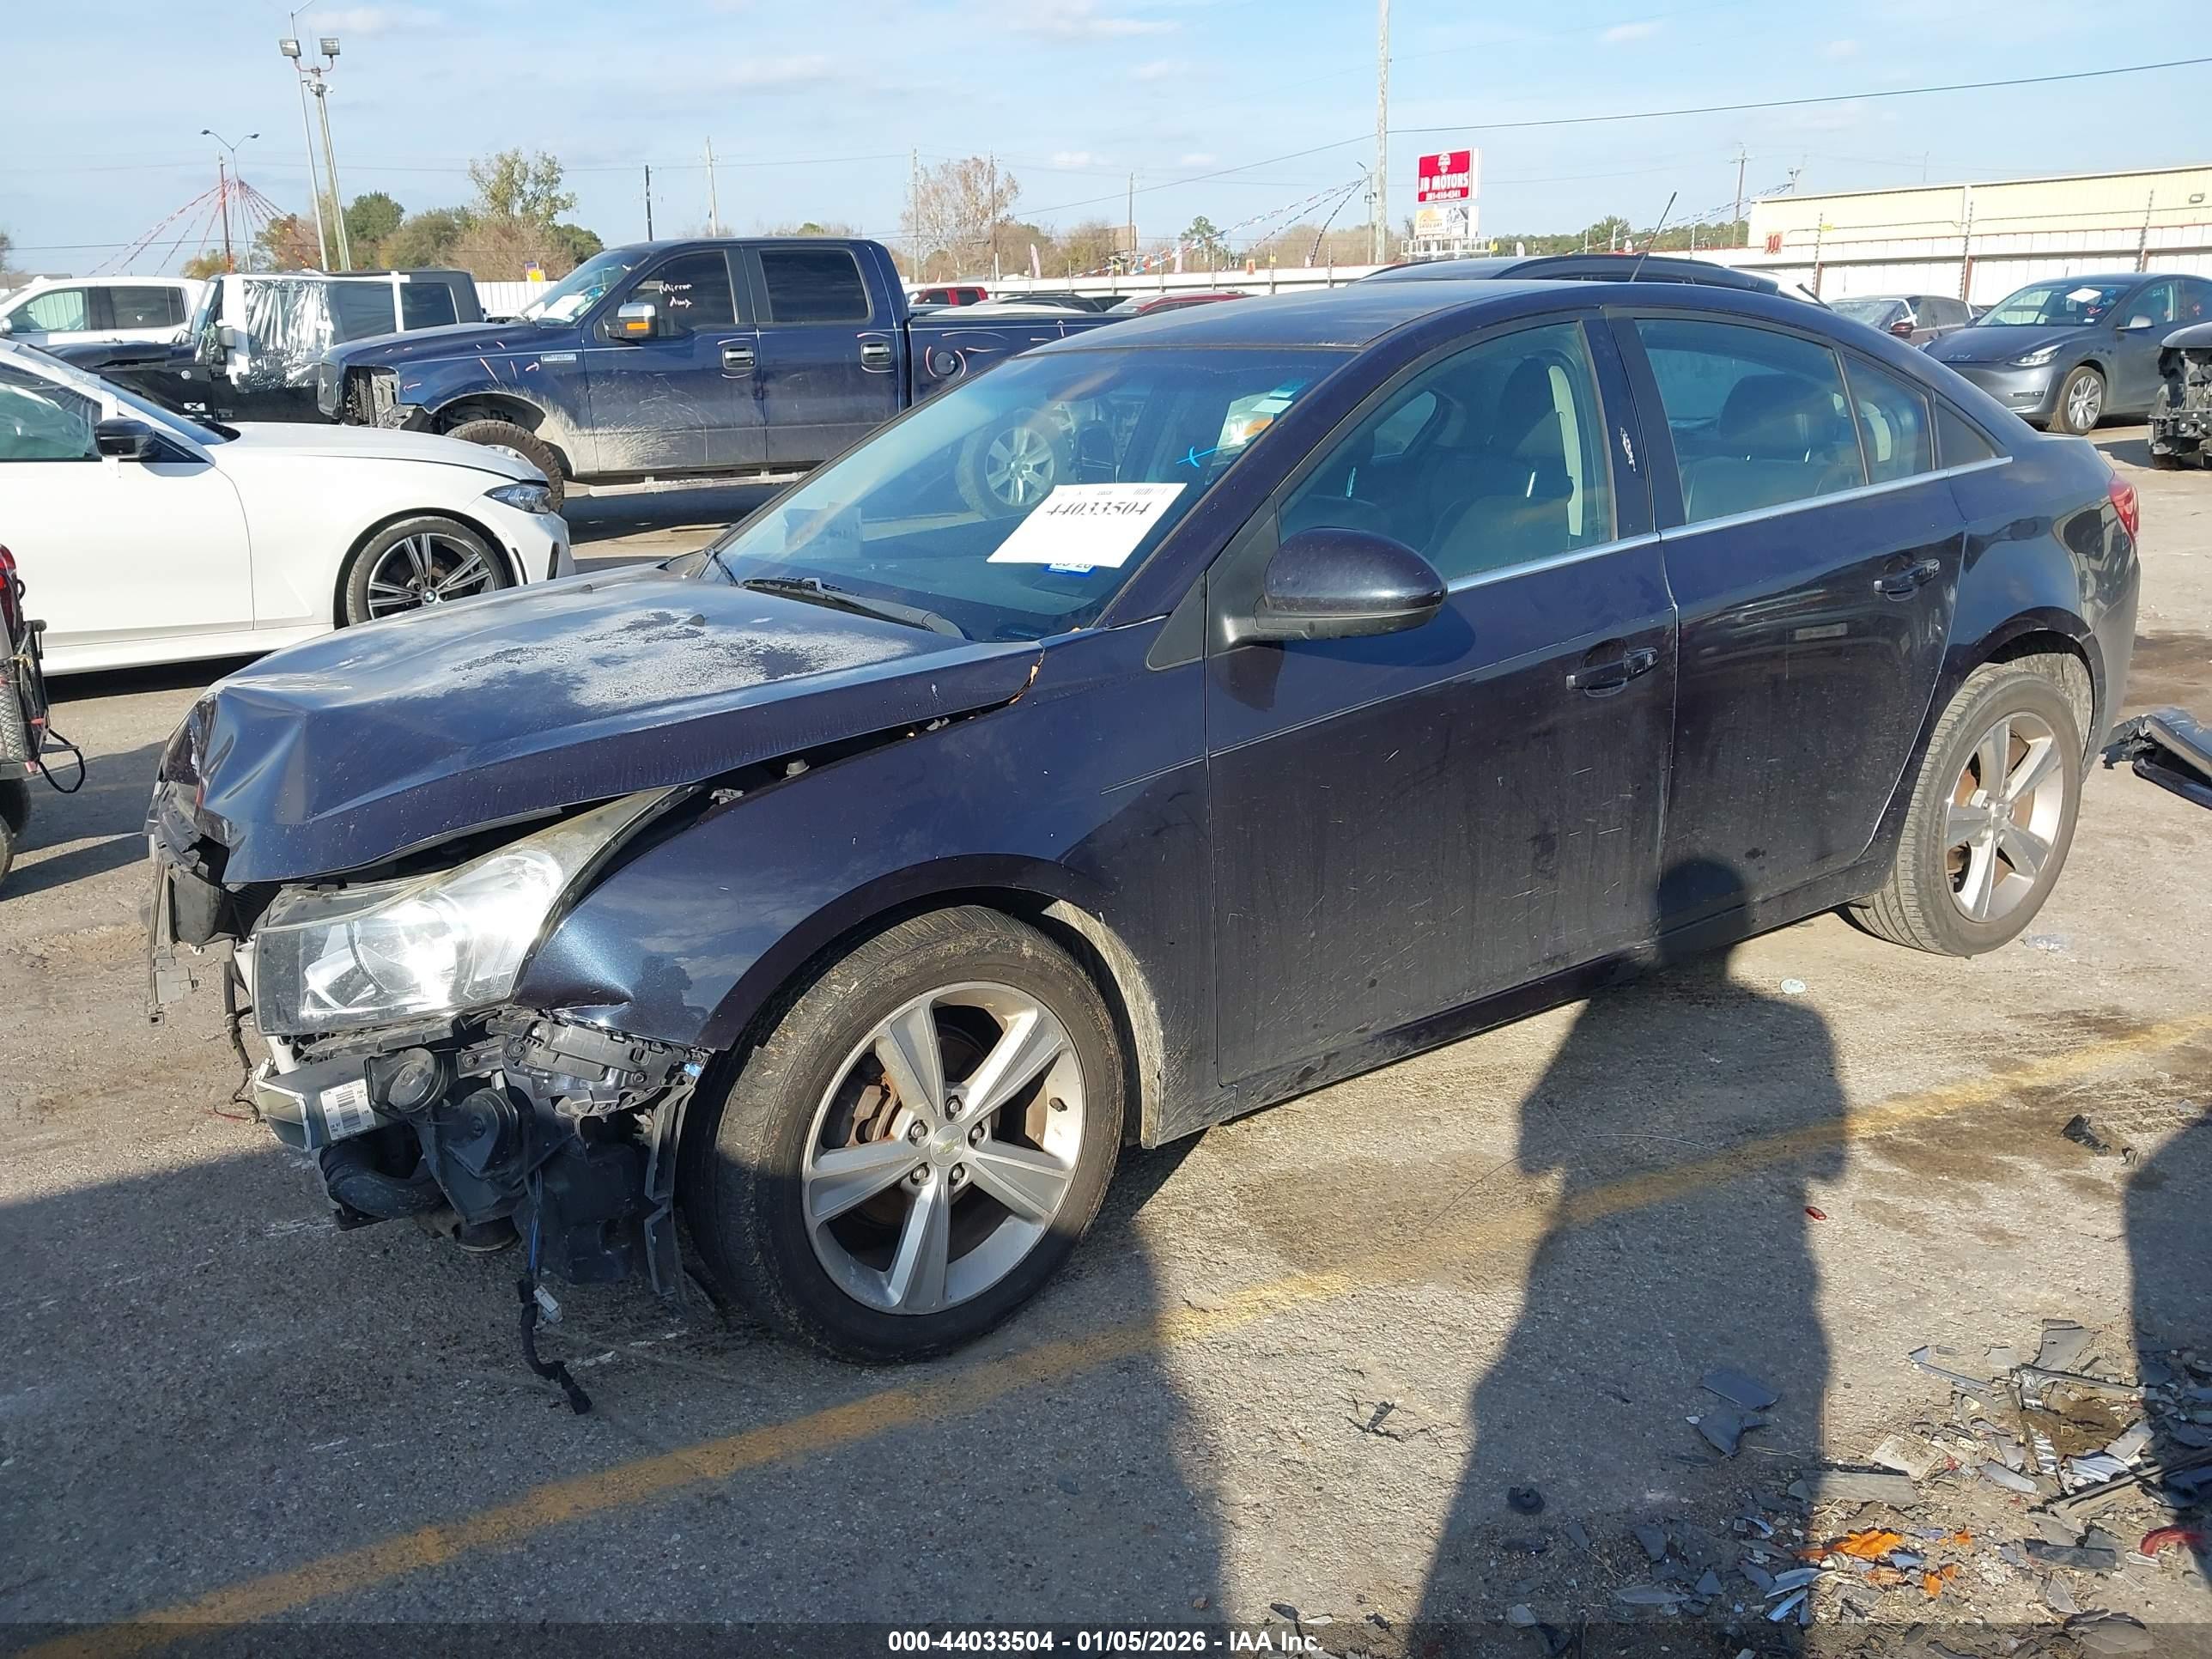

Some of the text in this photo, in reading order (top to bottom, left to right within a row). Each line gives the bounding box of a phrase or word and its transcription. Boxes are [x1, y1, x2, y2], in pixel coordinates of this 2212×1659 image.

[1431, 172, 1469, 191] MOTORS
[1766, 234, 1780, 252] 10
[659, 283, 692, 294] Mirror
[1046, 501, 1153, 516] 44033504
